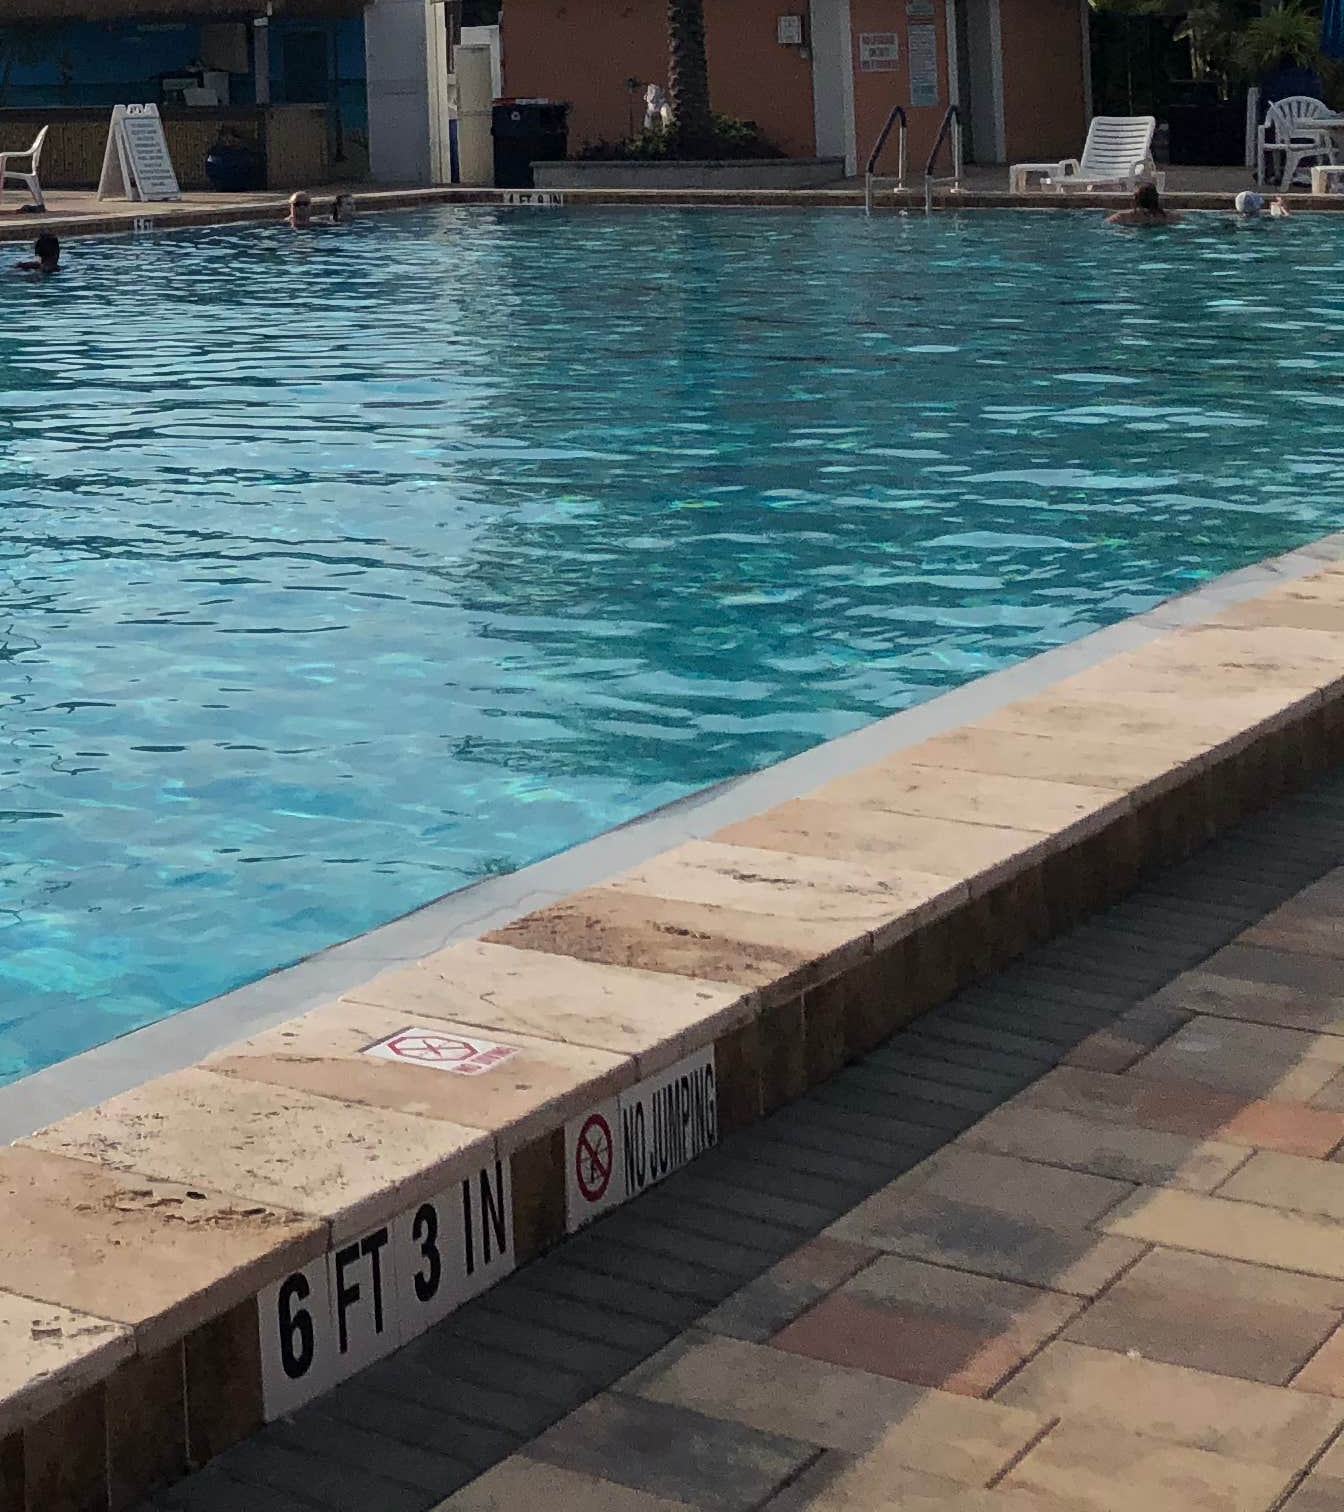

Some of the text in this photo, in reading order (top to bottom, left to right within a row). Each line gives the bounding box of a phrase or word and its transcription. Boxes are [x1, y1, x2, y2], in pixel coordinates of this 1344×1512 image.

[623, 1063, 715, 1196] NO JUMPING
[278, 1158, 507, 1379] 6 FT 3 IN
